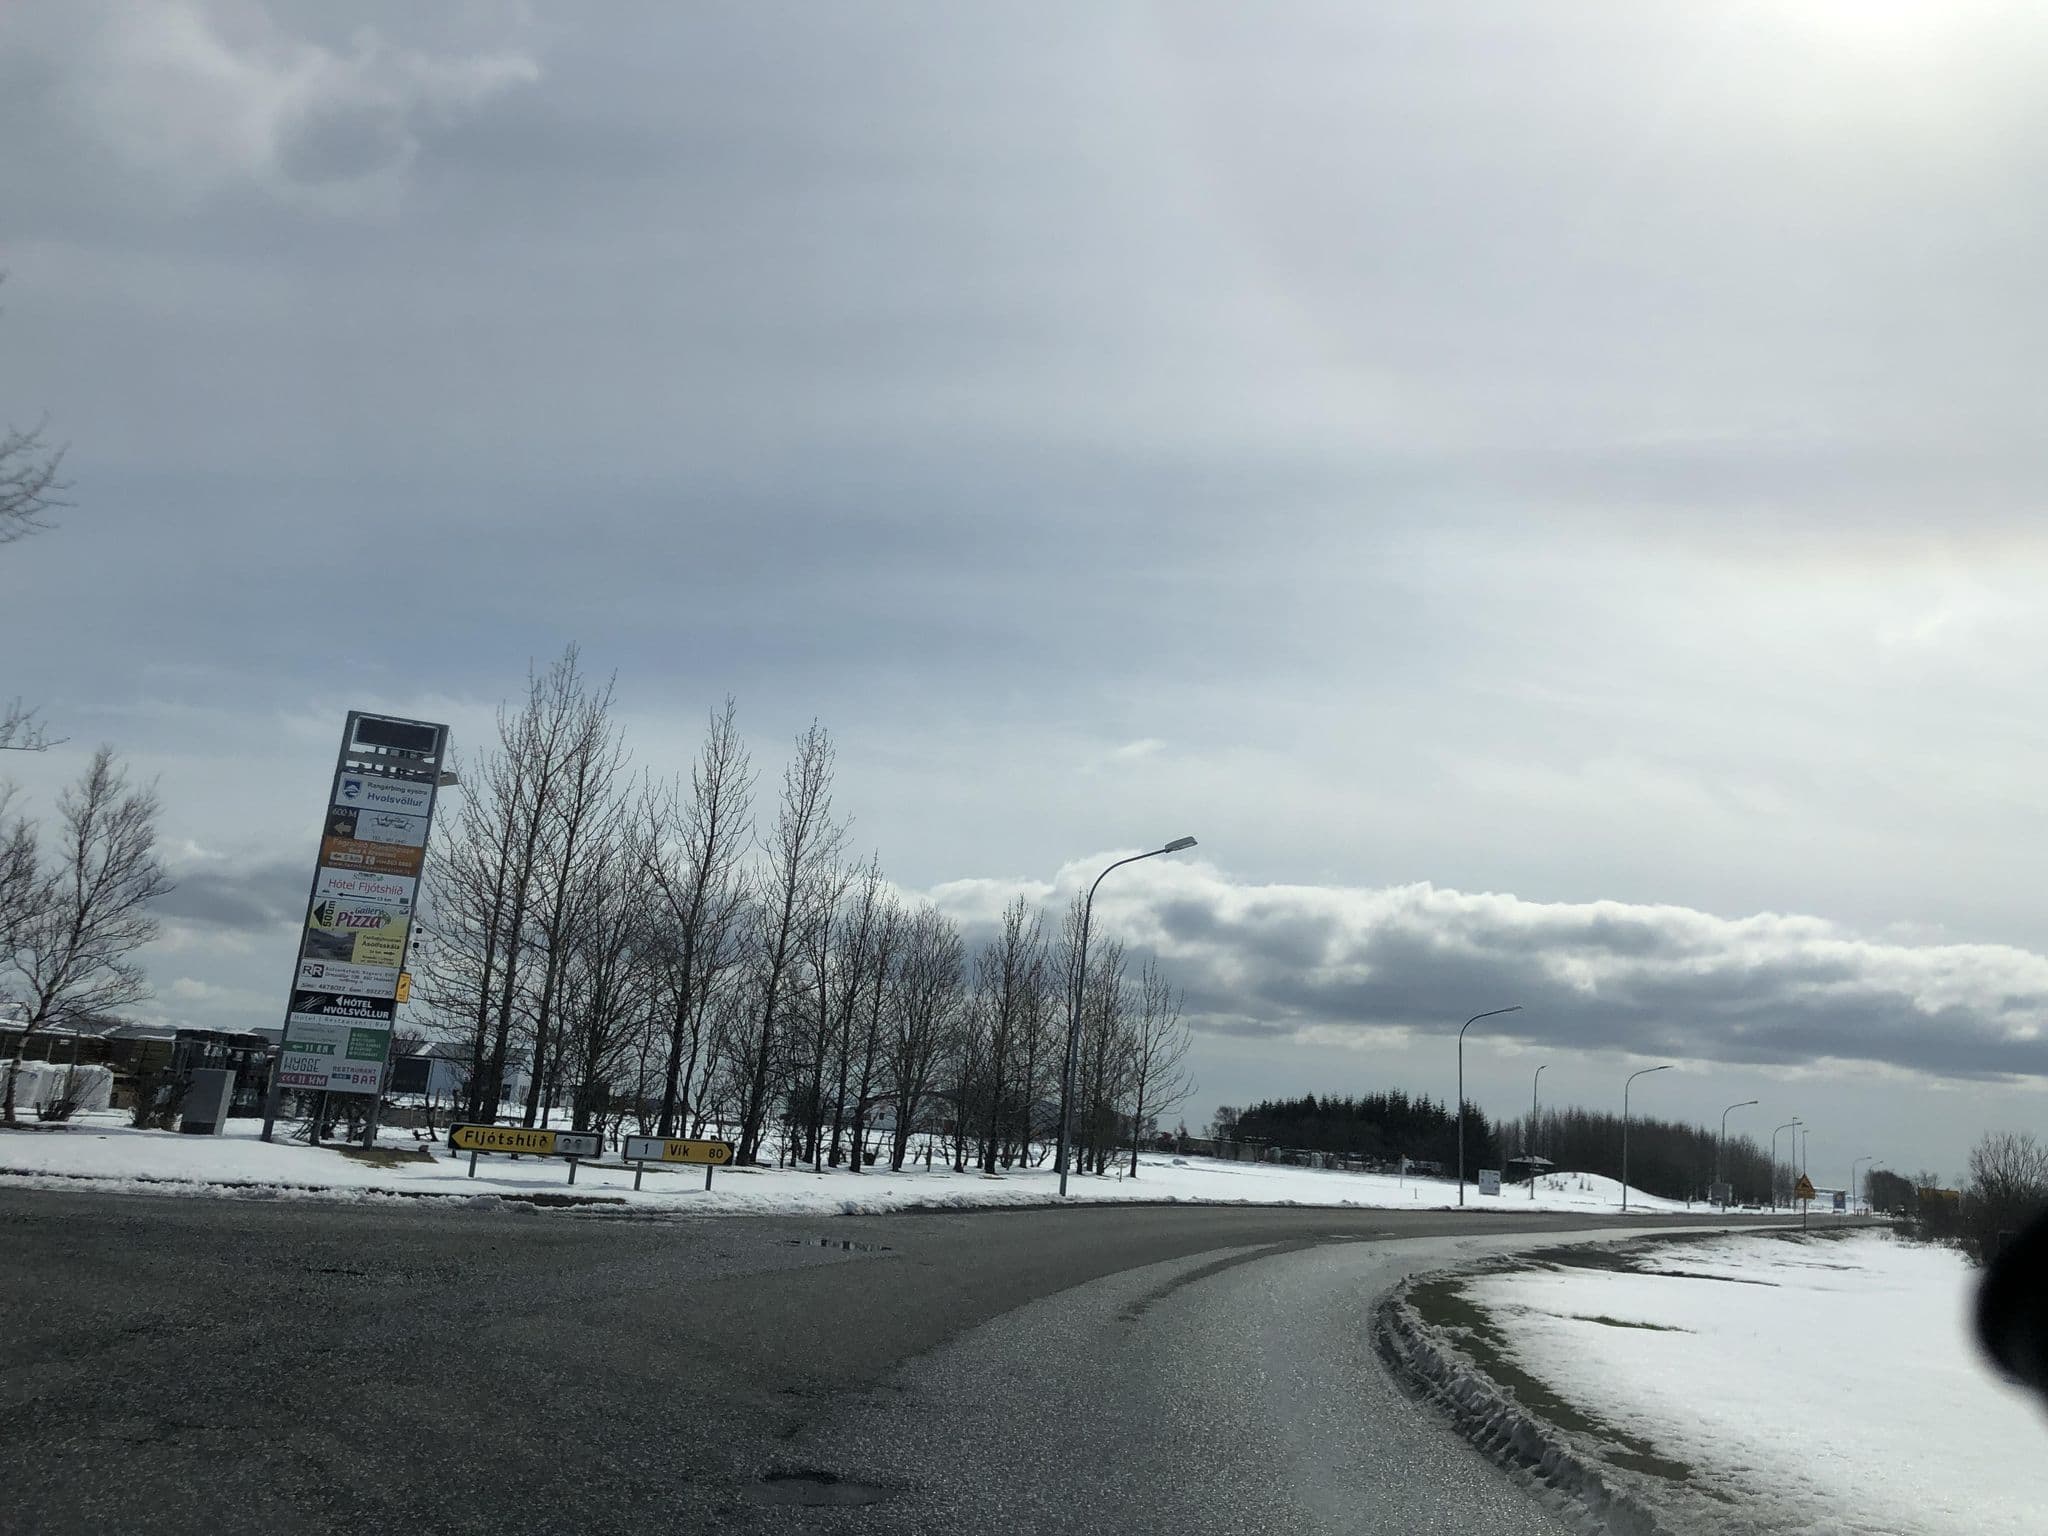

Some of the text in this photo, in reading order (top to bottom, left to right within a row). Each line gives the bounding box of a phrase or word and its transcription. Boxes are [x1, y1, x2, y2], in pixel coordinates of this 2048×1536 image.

[367, 791, 424, 807] Hvolsvöllur
[329, 878, 355, 890] Hótel
[323, 900, 336, 927] 500m
[335, 911, 382, 928] Pizza
[323, 1006, 390, 1019] HVOLSVÖLLUR
[309, 1075, 327, 1085] KM
[352, 1074, 377, 1086] BAR
[643, 1143, 649, 1155] 1
[708, 1148, 724, 1159] 80
